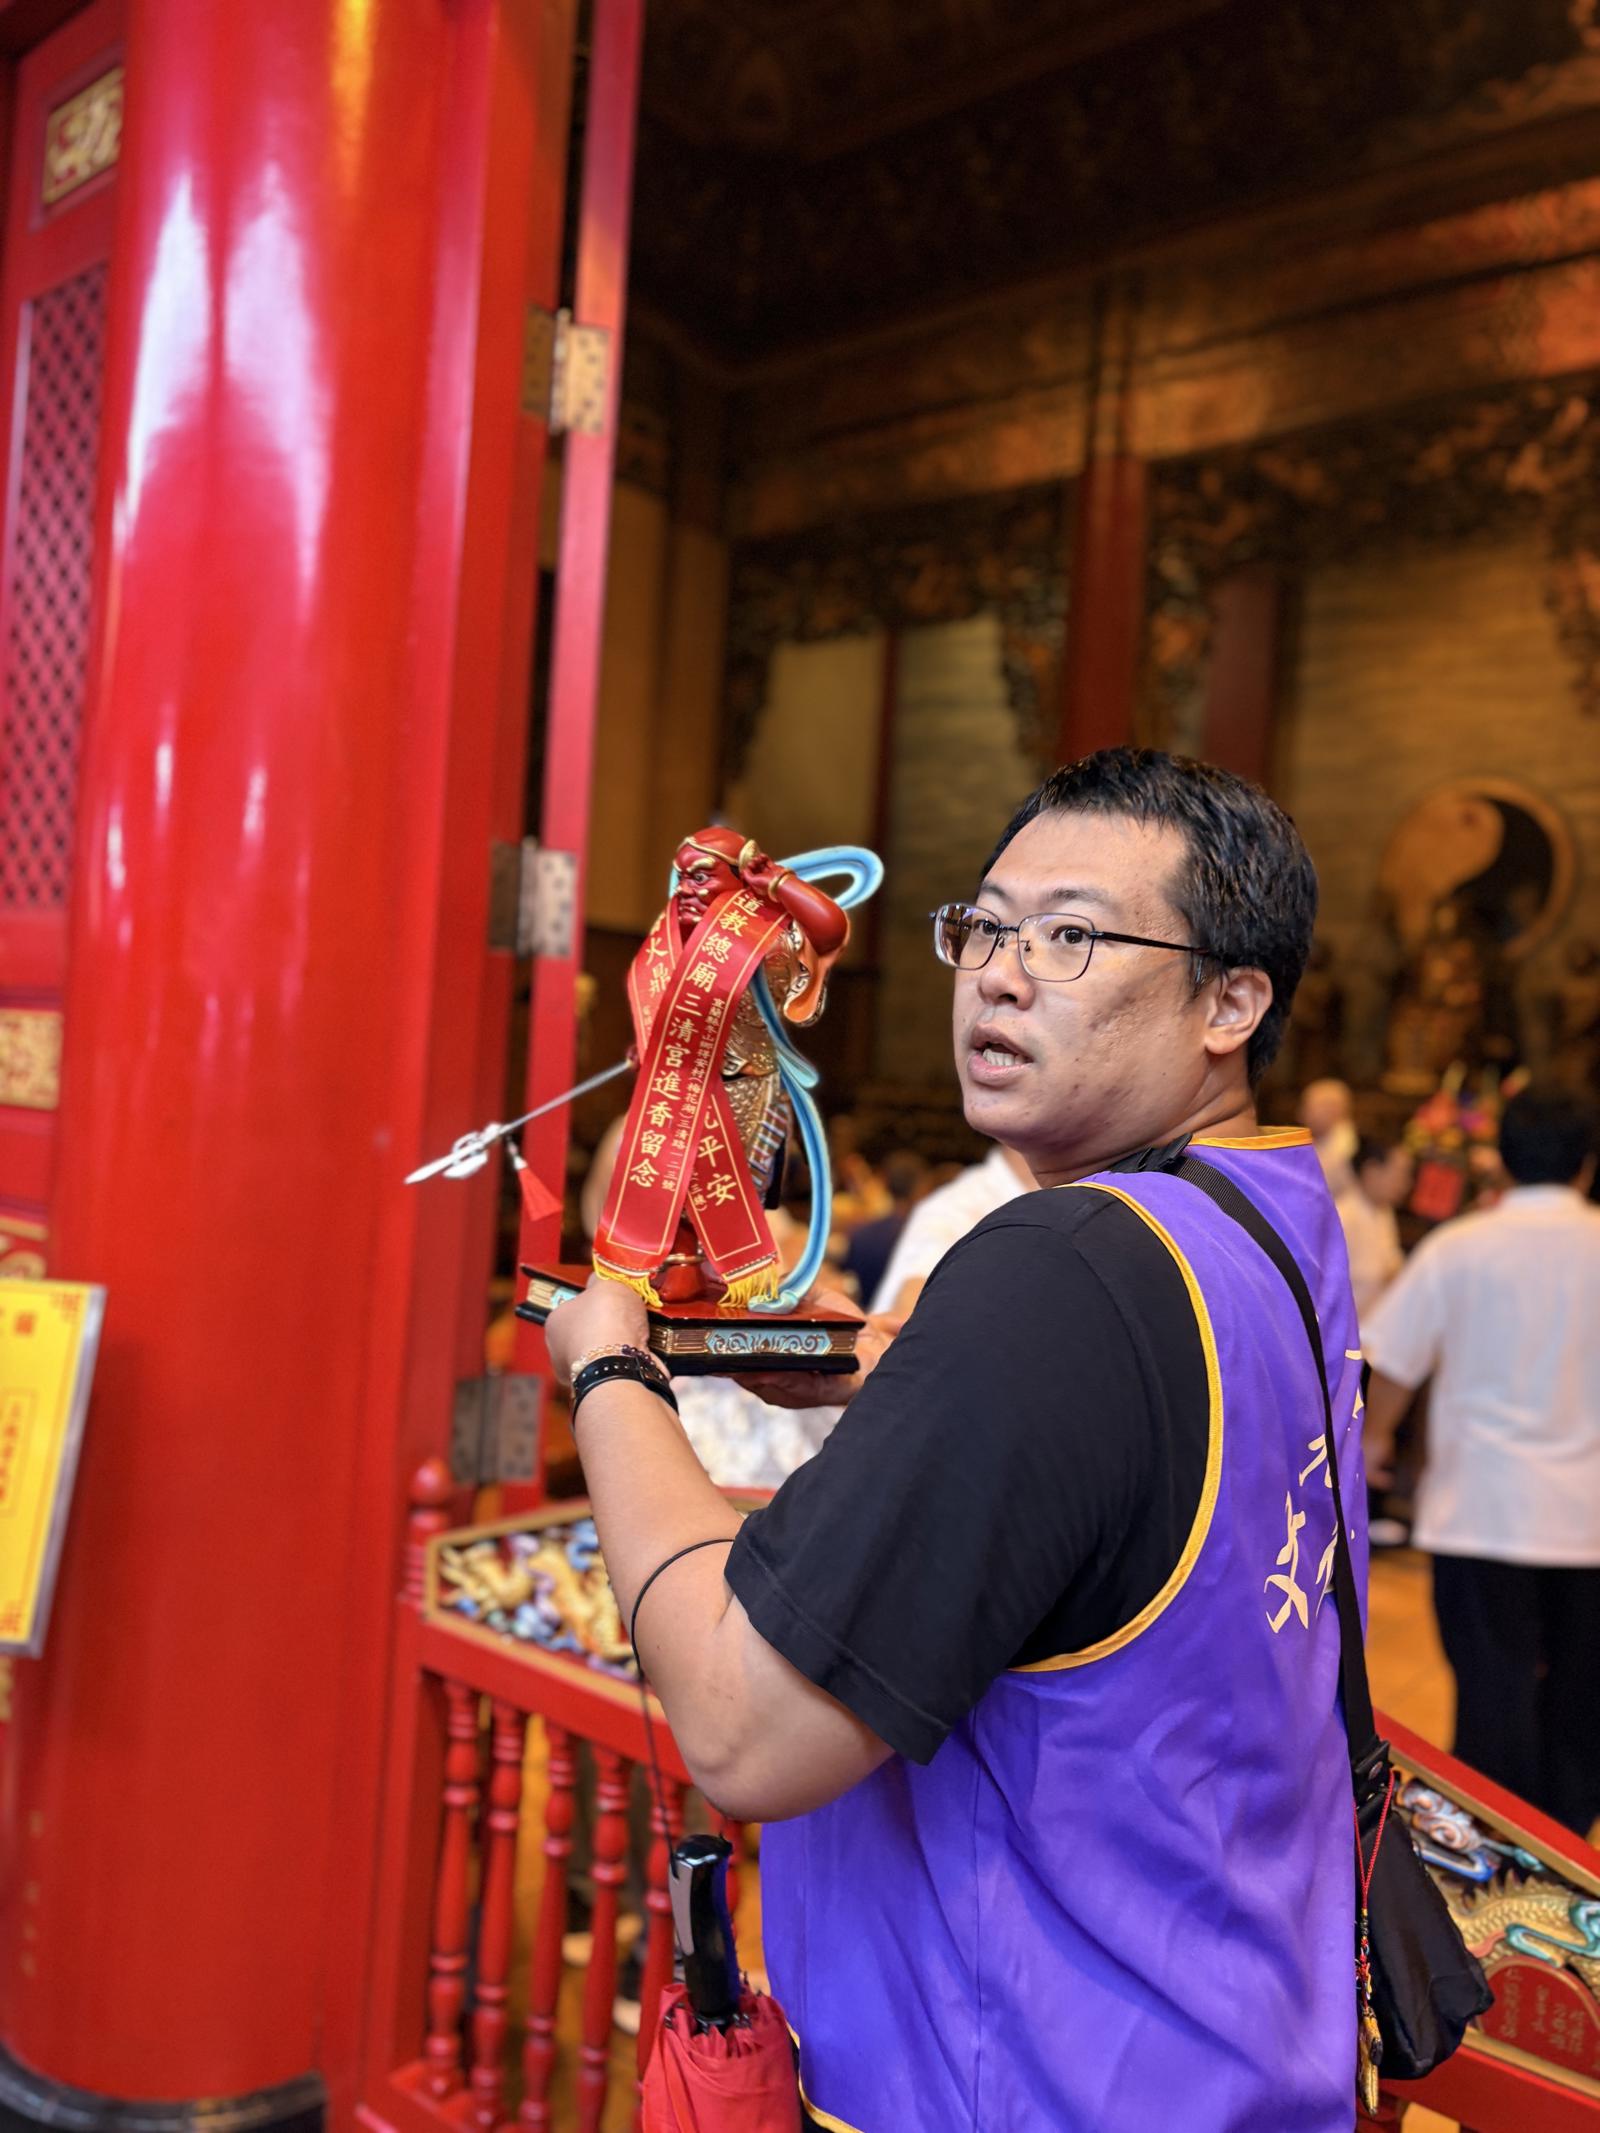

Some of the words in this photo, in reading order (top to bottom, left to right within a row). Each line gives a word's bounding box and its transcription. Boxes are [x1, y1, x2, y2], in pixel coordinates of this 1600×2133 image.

[630, 893, 764, 1188] 道教總廟三清宮進香留念
